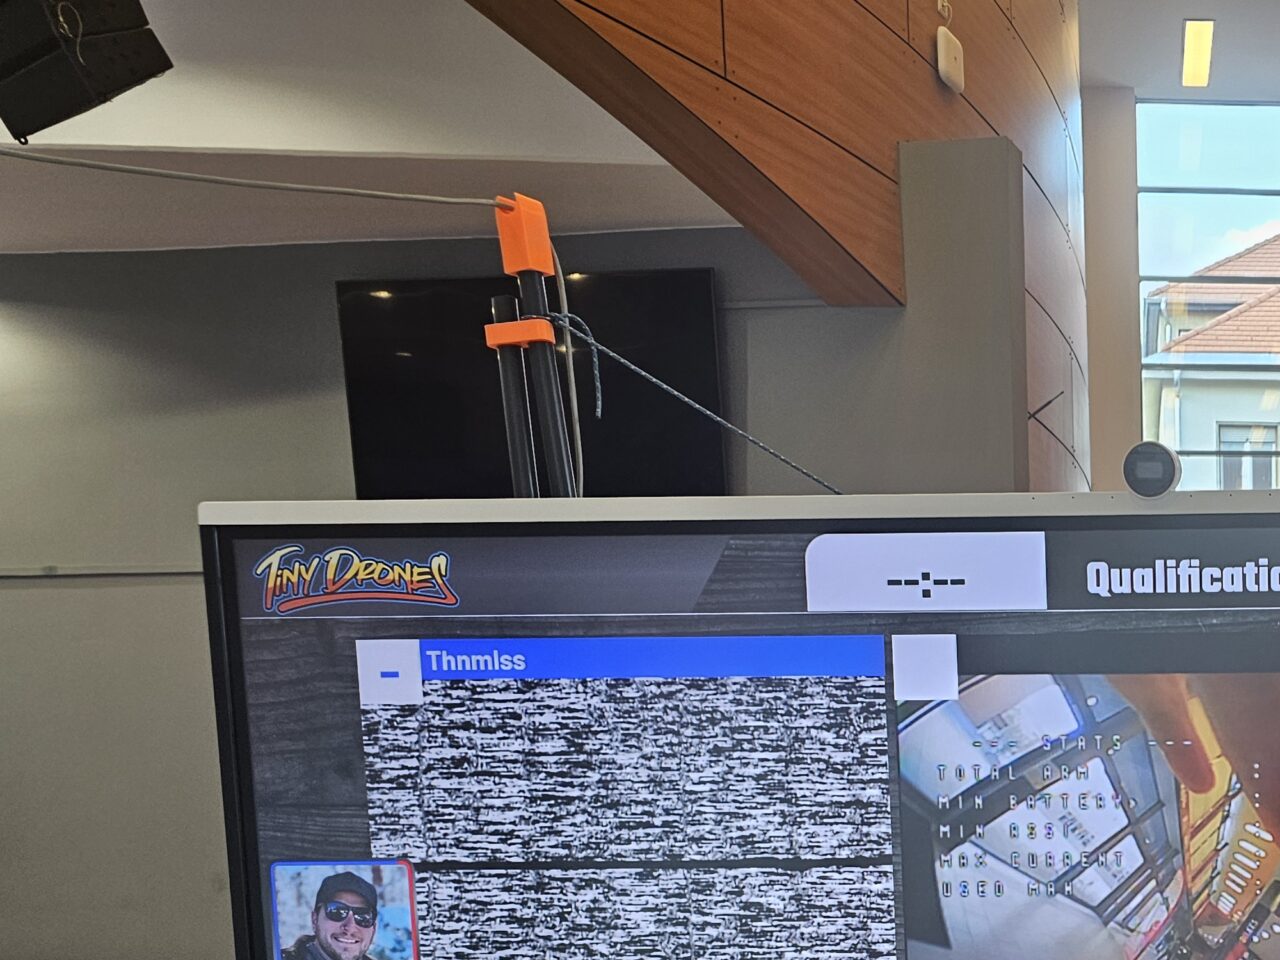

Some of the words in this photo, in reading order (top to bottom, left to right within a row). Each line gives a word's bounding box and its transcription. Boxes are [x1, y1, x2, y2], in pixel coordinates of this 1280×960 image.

[426, 649, 526, 673] Thnmlss
[937, 764, 1016, 781] TOTAL
[1043, 764, 1089, 781] ARM
[938, 795, 983, 809] MIN
[939, 824, 985, 839] MIN
